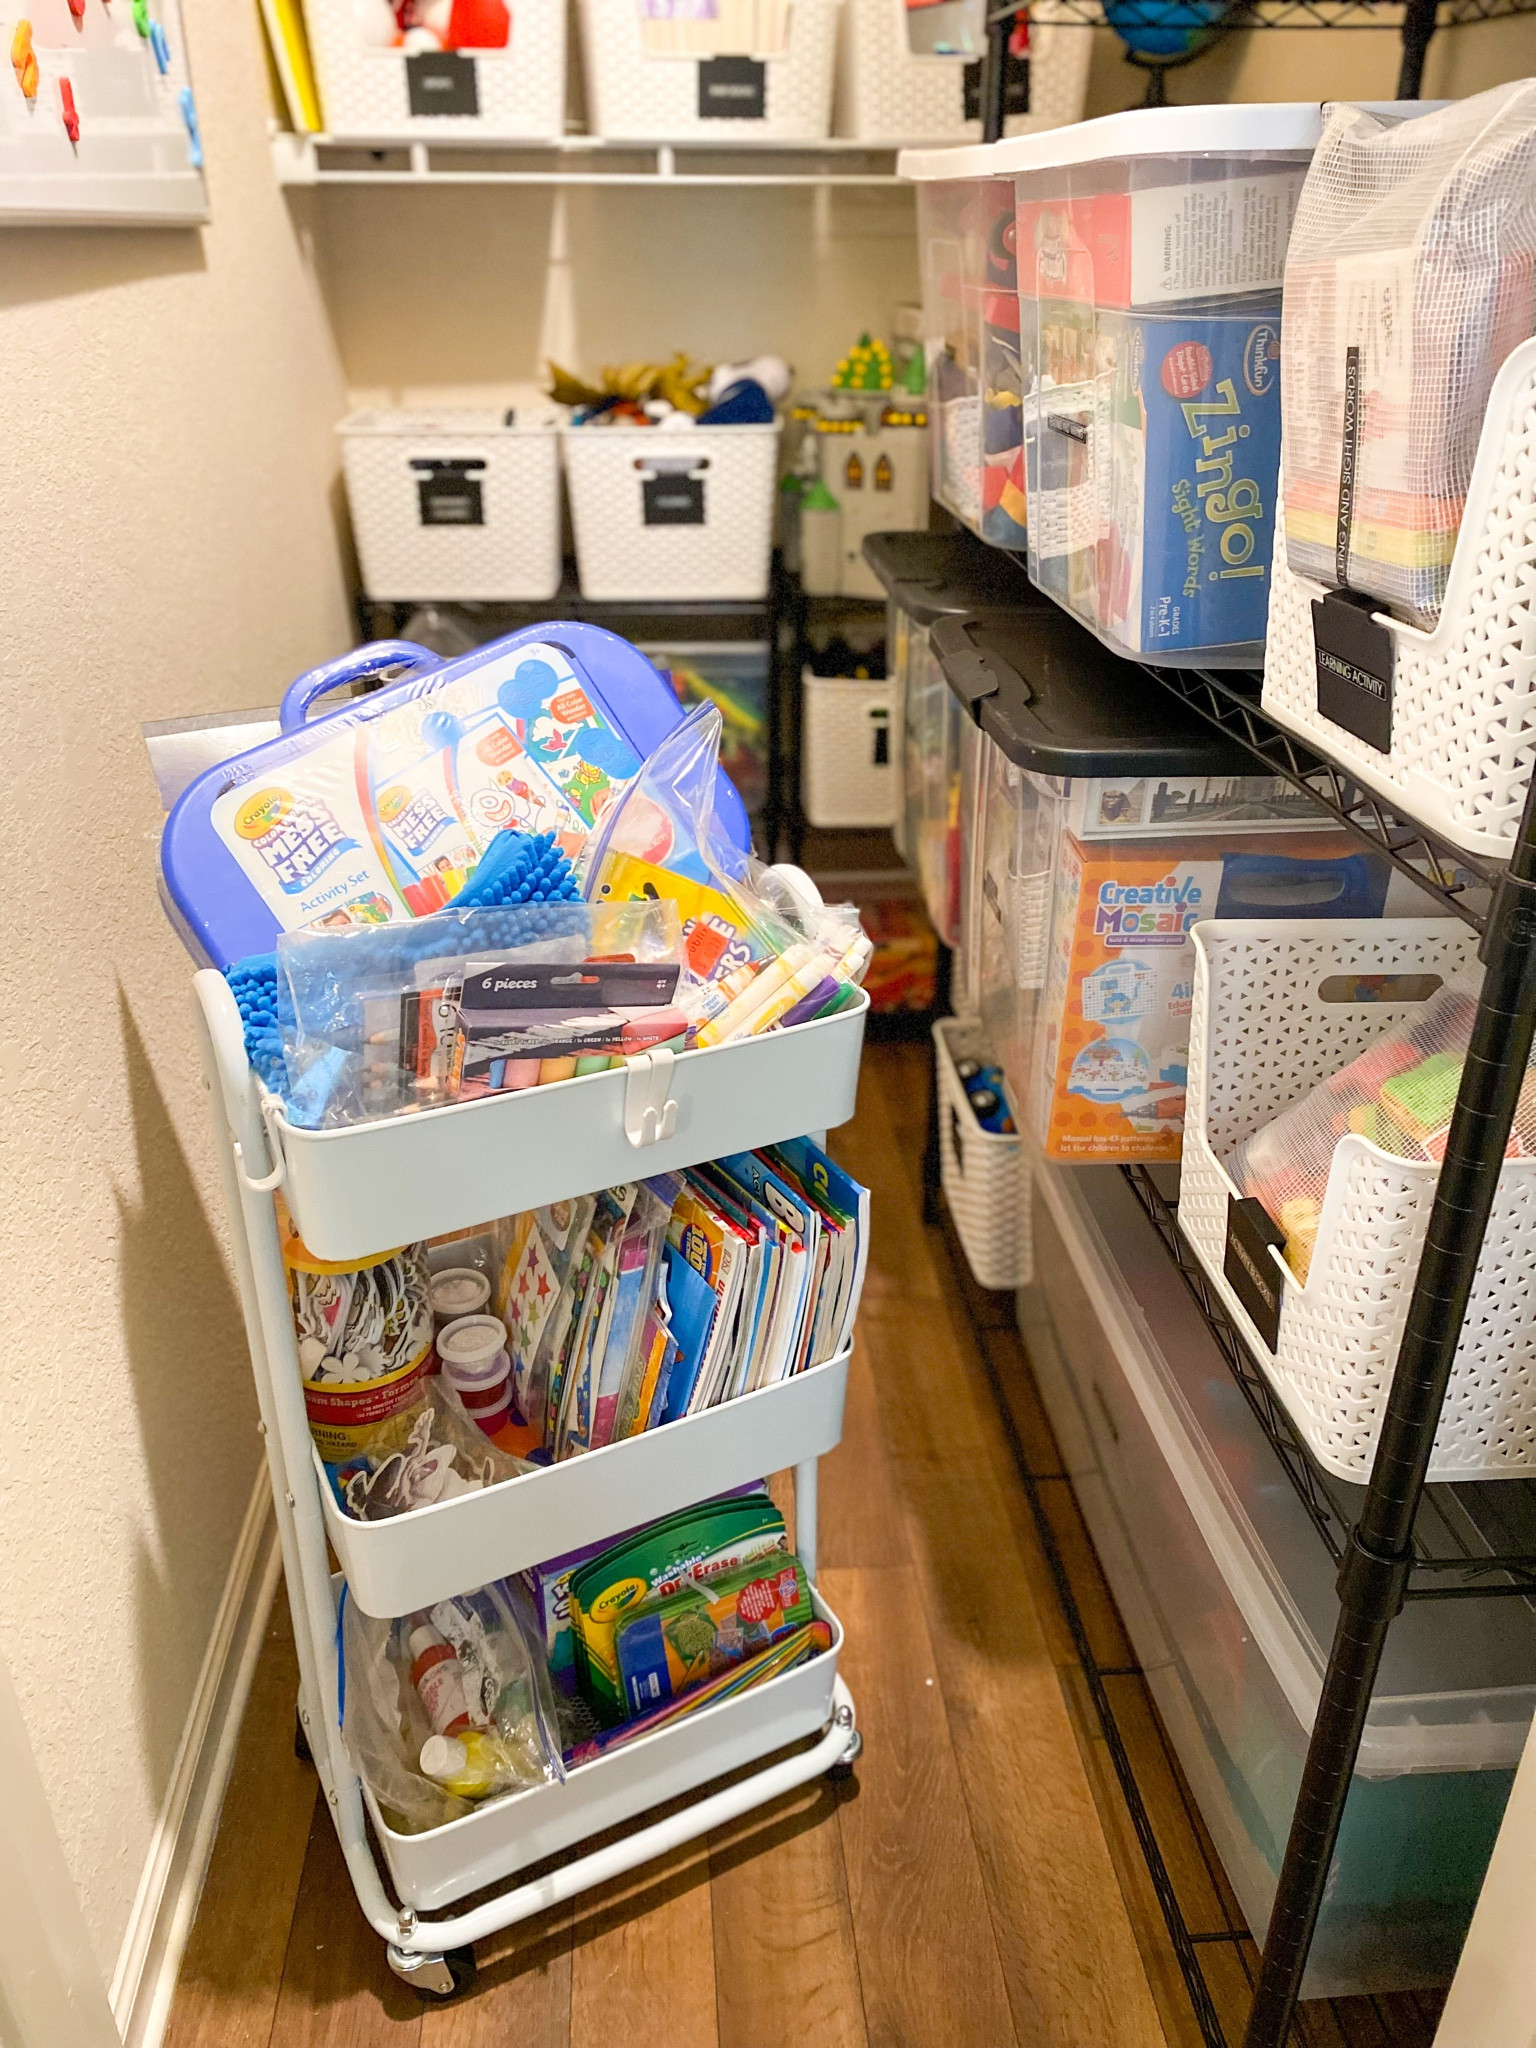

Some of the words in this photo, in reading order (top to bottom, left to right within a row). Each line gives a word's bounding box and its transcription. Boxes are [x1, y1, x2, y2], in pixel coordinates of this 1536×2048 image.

[1345, 366, 1356, 432] WORDS
[1181, 378, 1265, 581] Zingo!
[1343, 435, 1353, 484] SIGHT
[1172, 479, 1202, 533] Sight
[1340, 489, 1350, 526] AND
[1182, 535, 1205, 598] Words
[1172, 606, 1180, 635] GRADES
[1319, 652, 1351, 679] LEARNING
[1352, 671, 1383, 696] ACTIVITY
[243, 794, 279, 826] Crayola
[392, 794, 438, 839] MESS
[402, 806, 448, 849] FREE
[274, 822, 347, 883] FREE
[301, 879, 348, 912] Activity
[348, 870, 370, 888] Set
[1100, 876, 1202, 904] Creative
[1095, 902, 1199, 932] Mosaic
[482, 978, 492, 989] 6
[494, 978, 538, 992] pieces
[690, 1224, 703, 1272] 100
[330, 1397, 372, 1408] Shapes
[651, 1555, 703, 1587] Washable
[692, 1556, 739, 1582] Erase
[599, 1584, 636, 1610] Crayola
